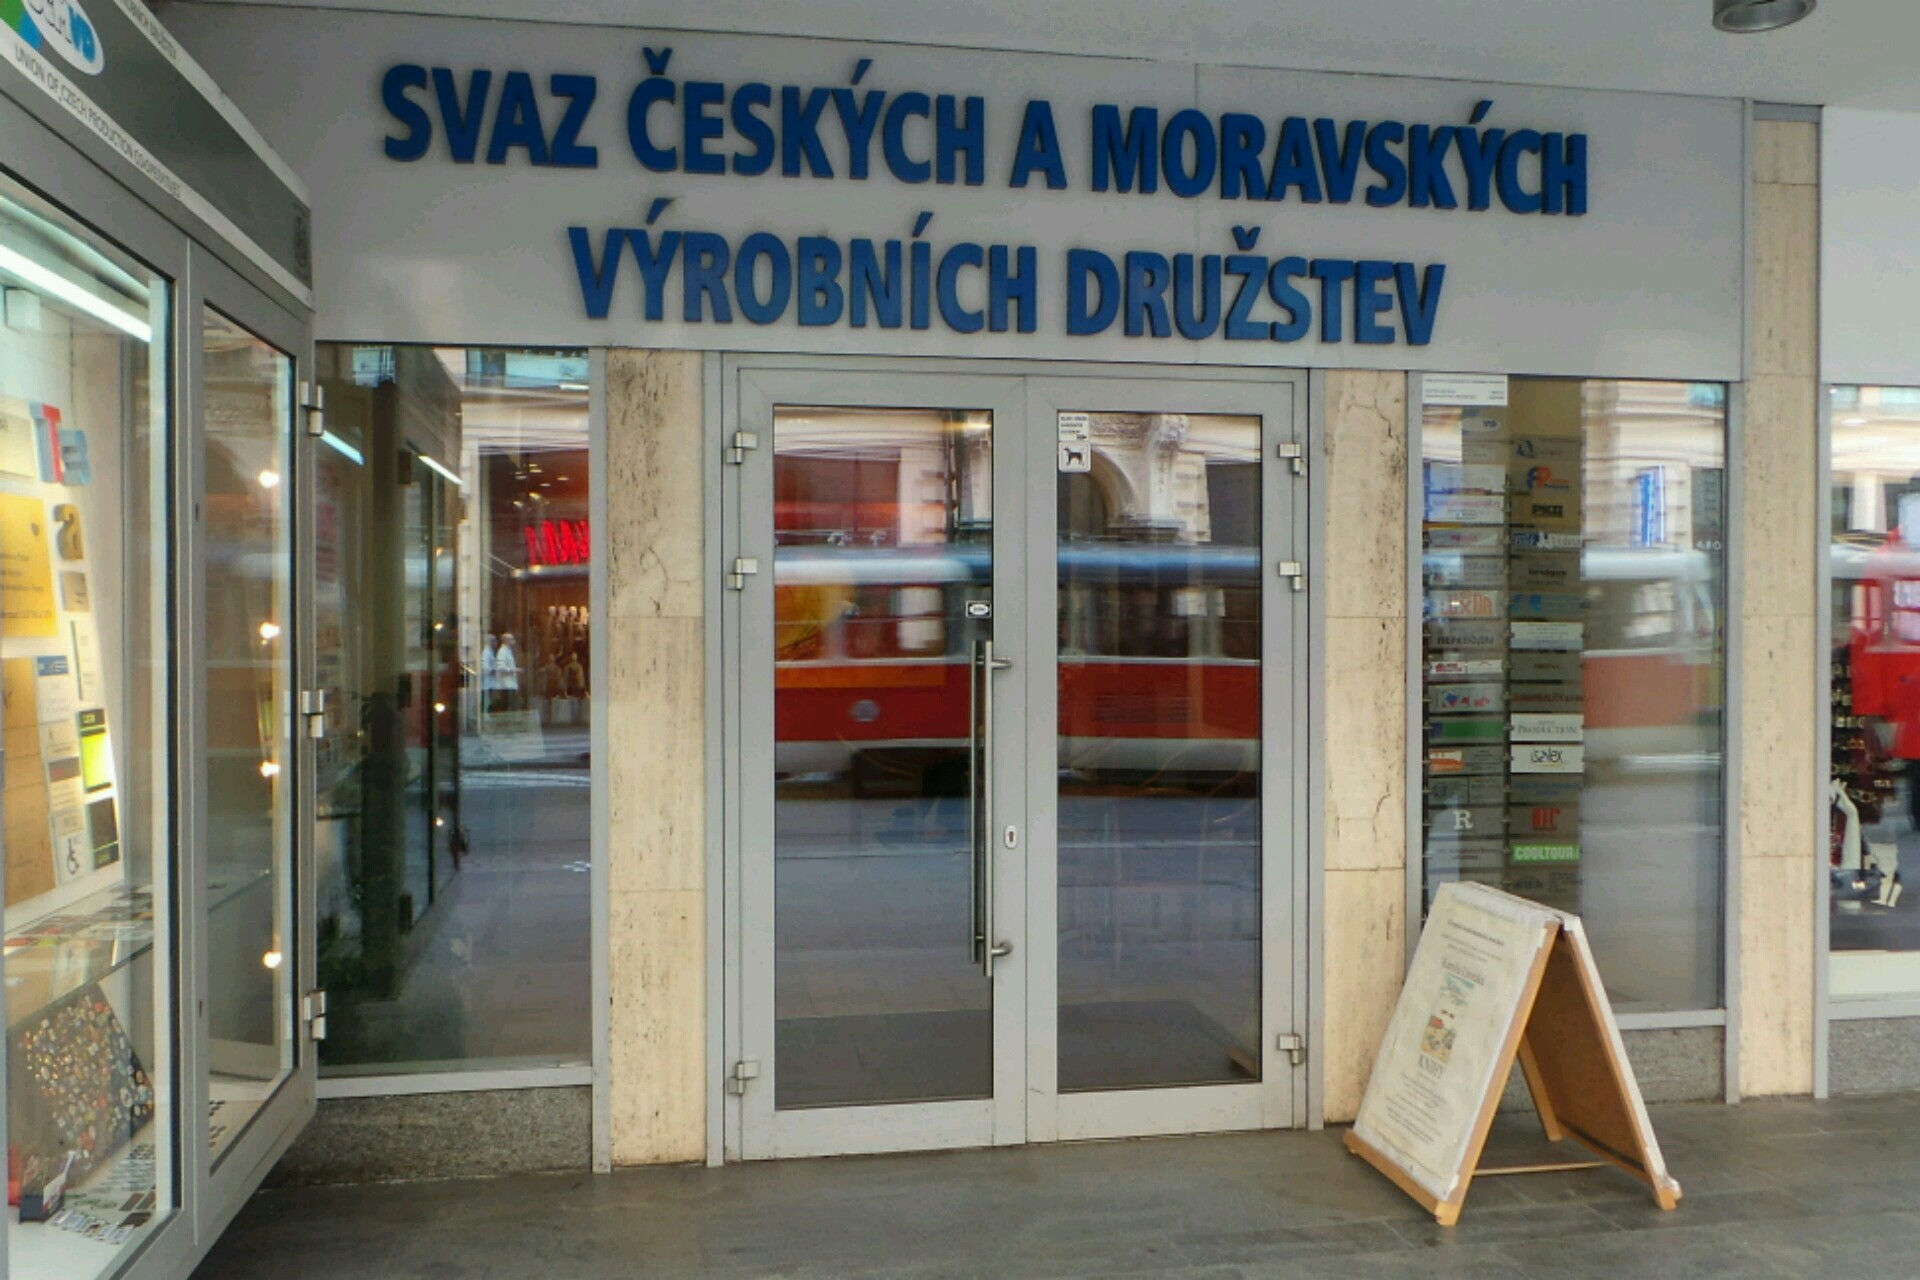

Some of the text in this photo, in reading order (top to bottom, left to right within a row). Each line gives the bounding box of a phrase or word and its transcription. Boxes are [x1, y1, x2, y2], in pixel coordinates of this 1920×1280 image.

[14, 45, 47, 84] UNION
[381, 47, 1588, 216] SVAZ ČESKÝCH A MORAVSKÝCH
[568, 198, 1446, 345] VÝROBNÍCH DRUŽSTEV
